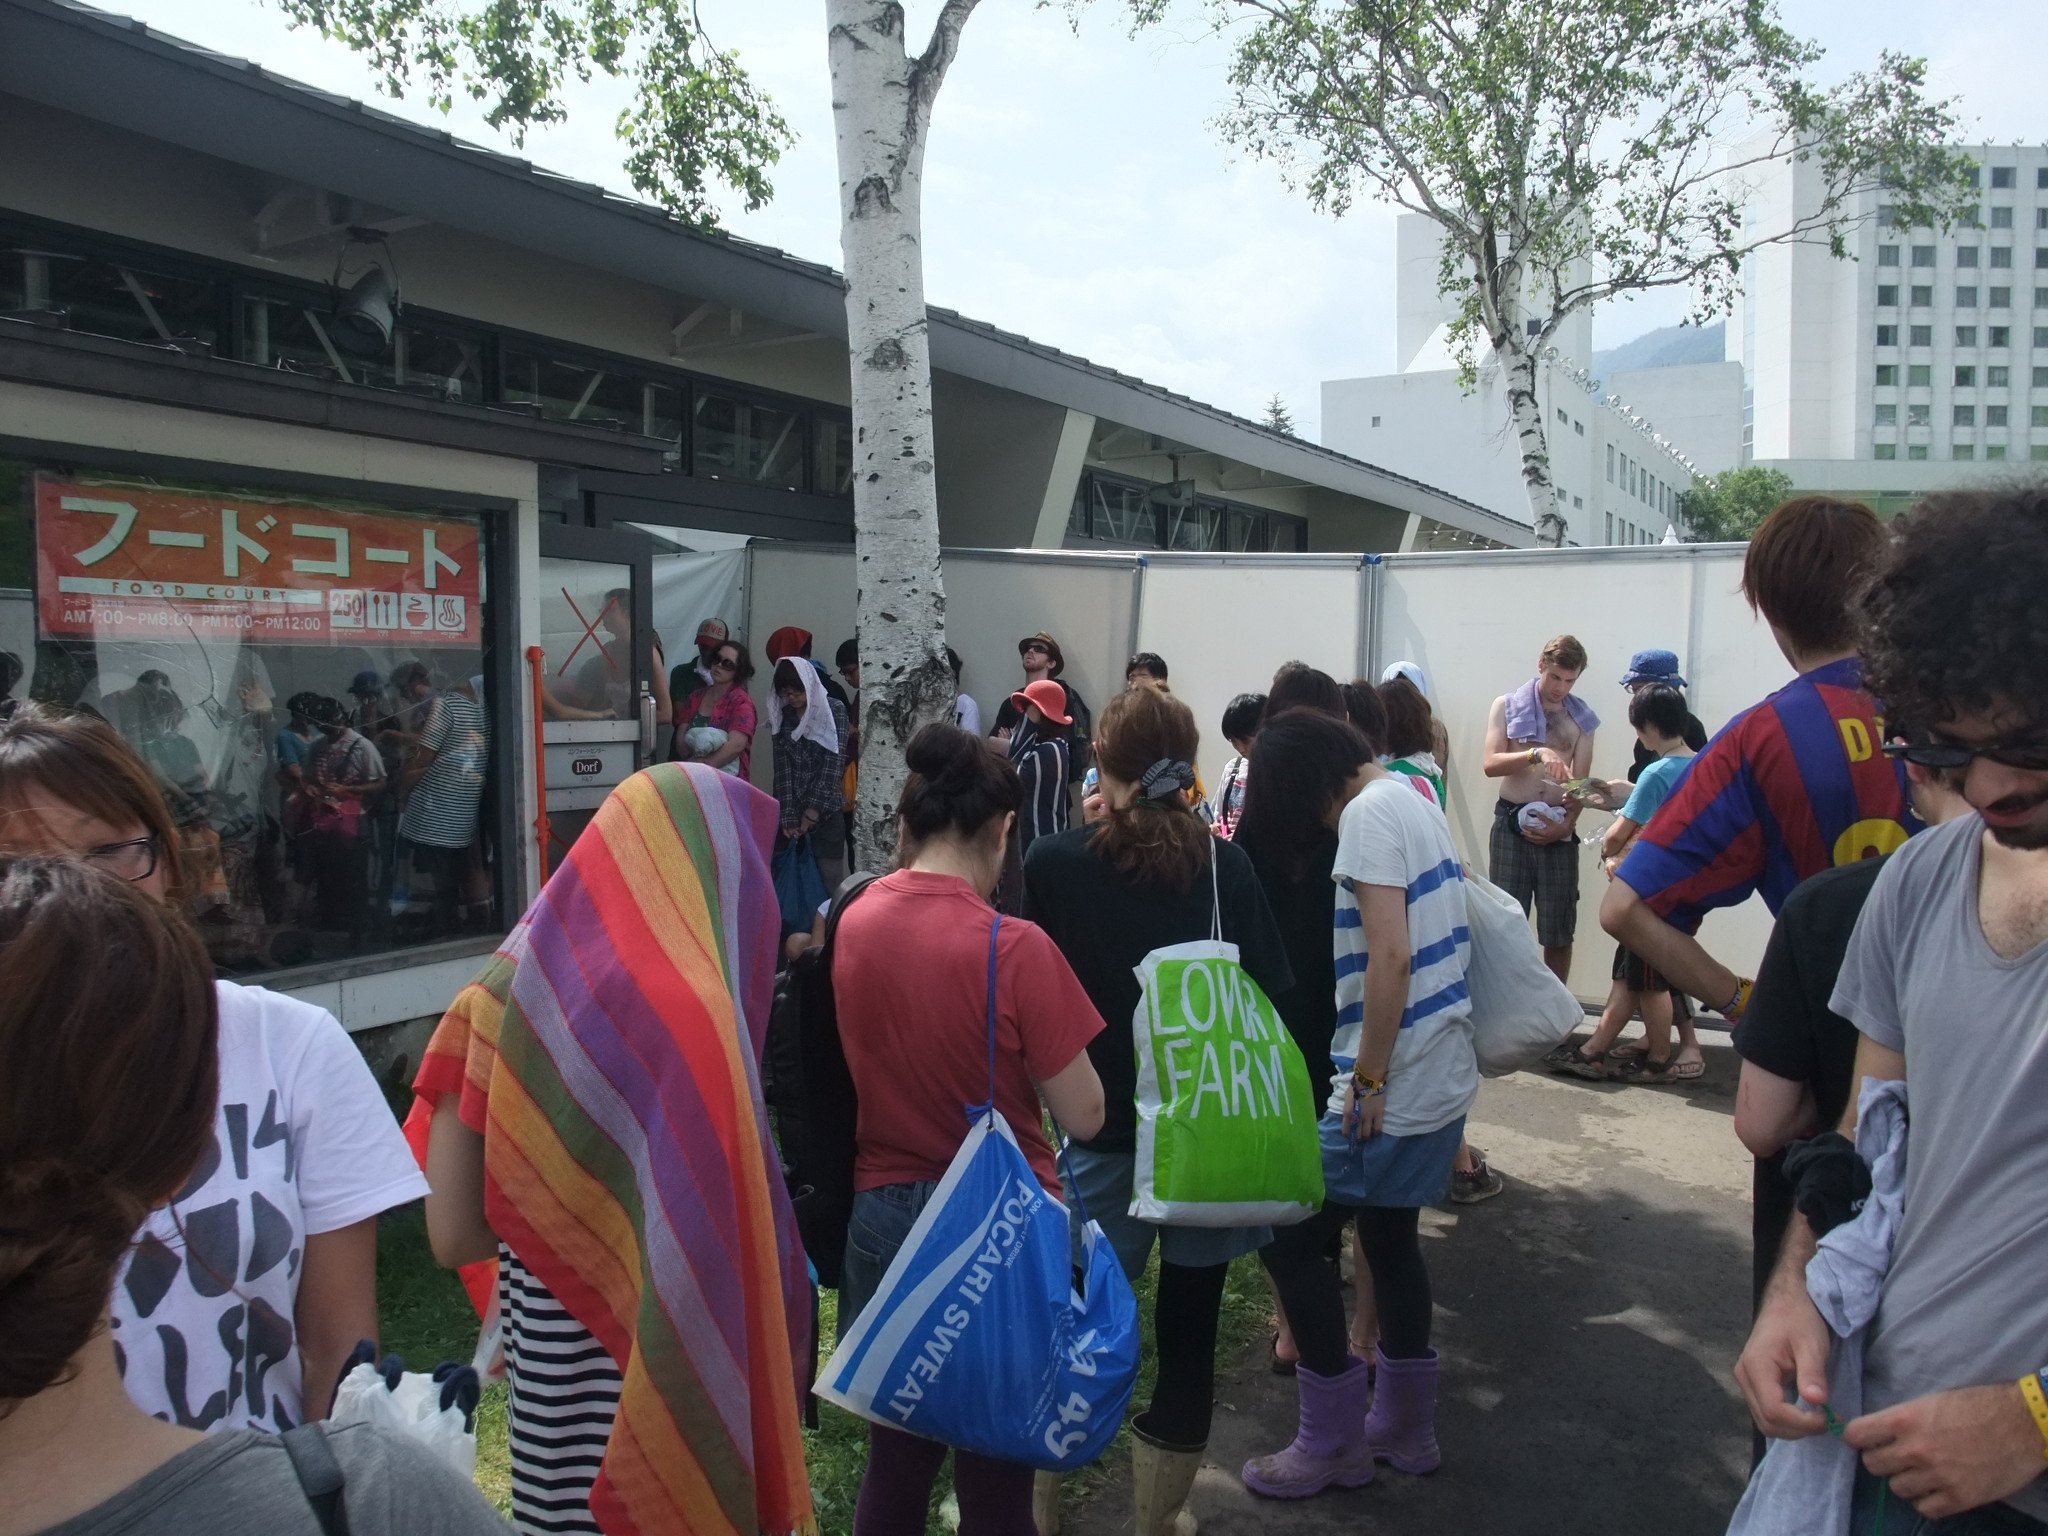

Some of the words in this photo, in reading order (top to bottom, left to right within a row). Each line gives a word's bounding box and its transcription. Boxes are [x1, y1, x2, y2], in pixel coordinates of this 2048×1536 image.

[60, 496, 461, 588] フードコート
[112, 581, 184, 597] FOOD
[206, 586, 286, 601] COURT
[576, 761, 598, 773] Dorf
[1163, 1038, 1293, 1125] FARM
[1029, 1198, 1044, 1214] ION
[959, 1178, 1036, 1306] POCARI
[1004, 1241, 1024, 1269] DRINK
[888, 1303, 971, 1422] SWEAT
